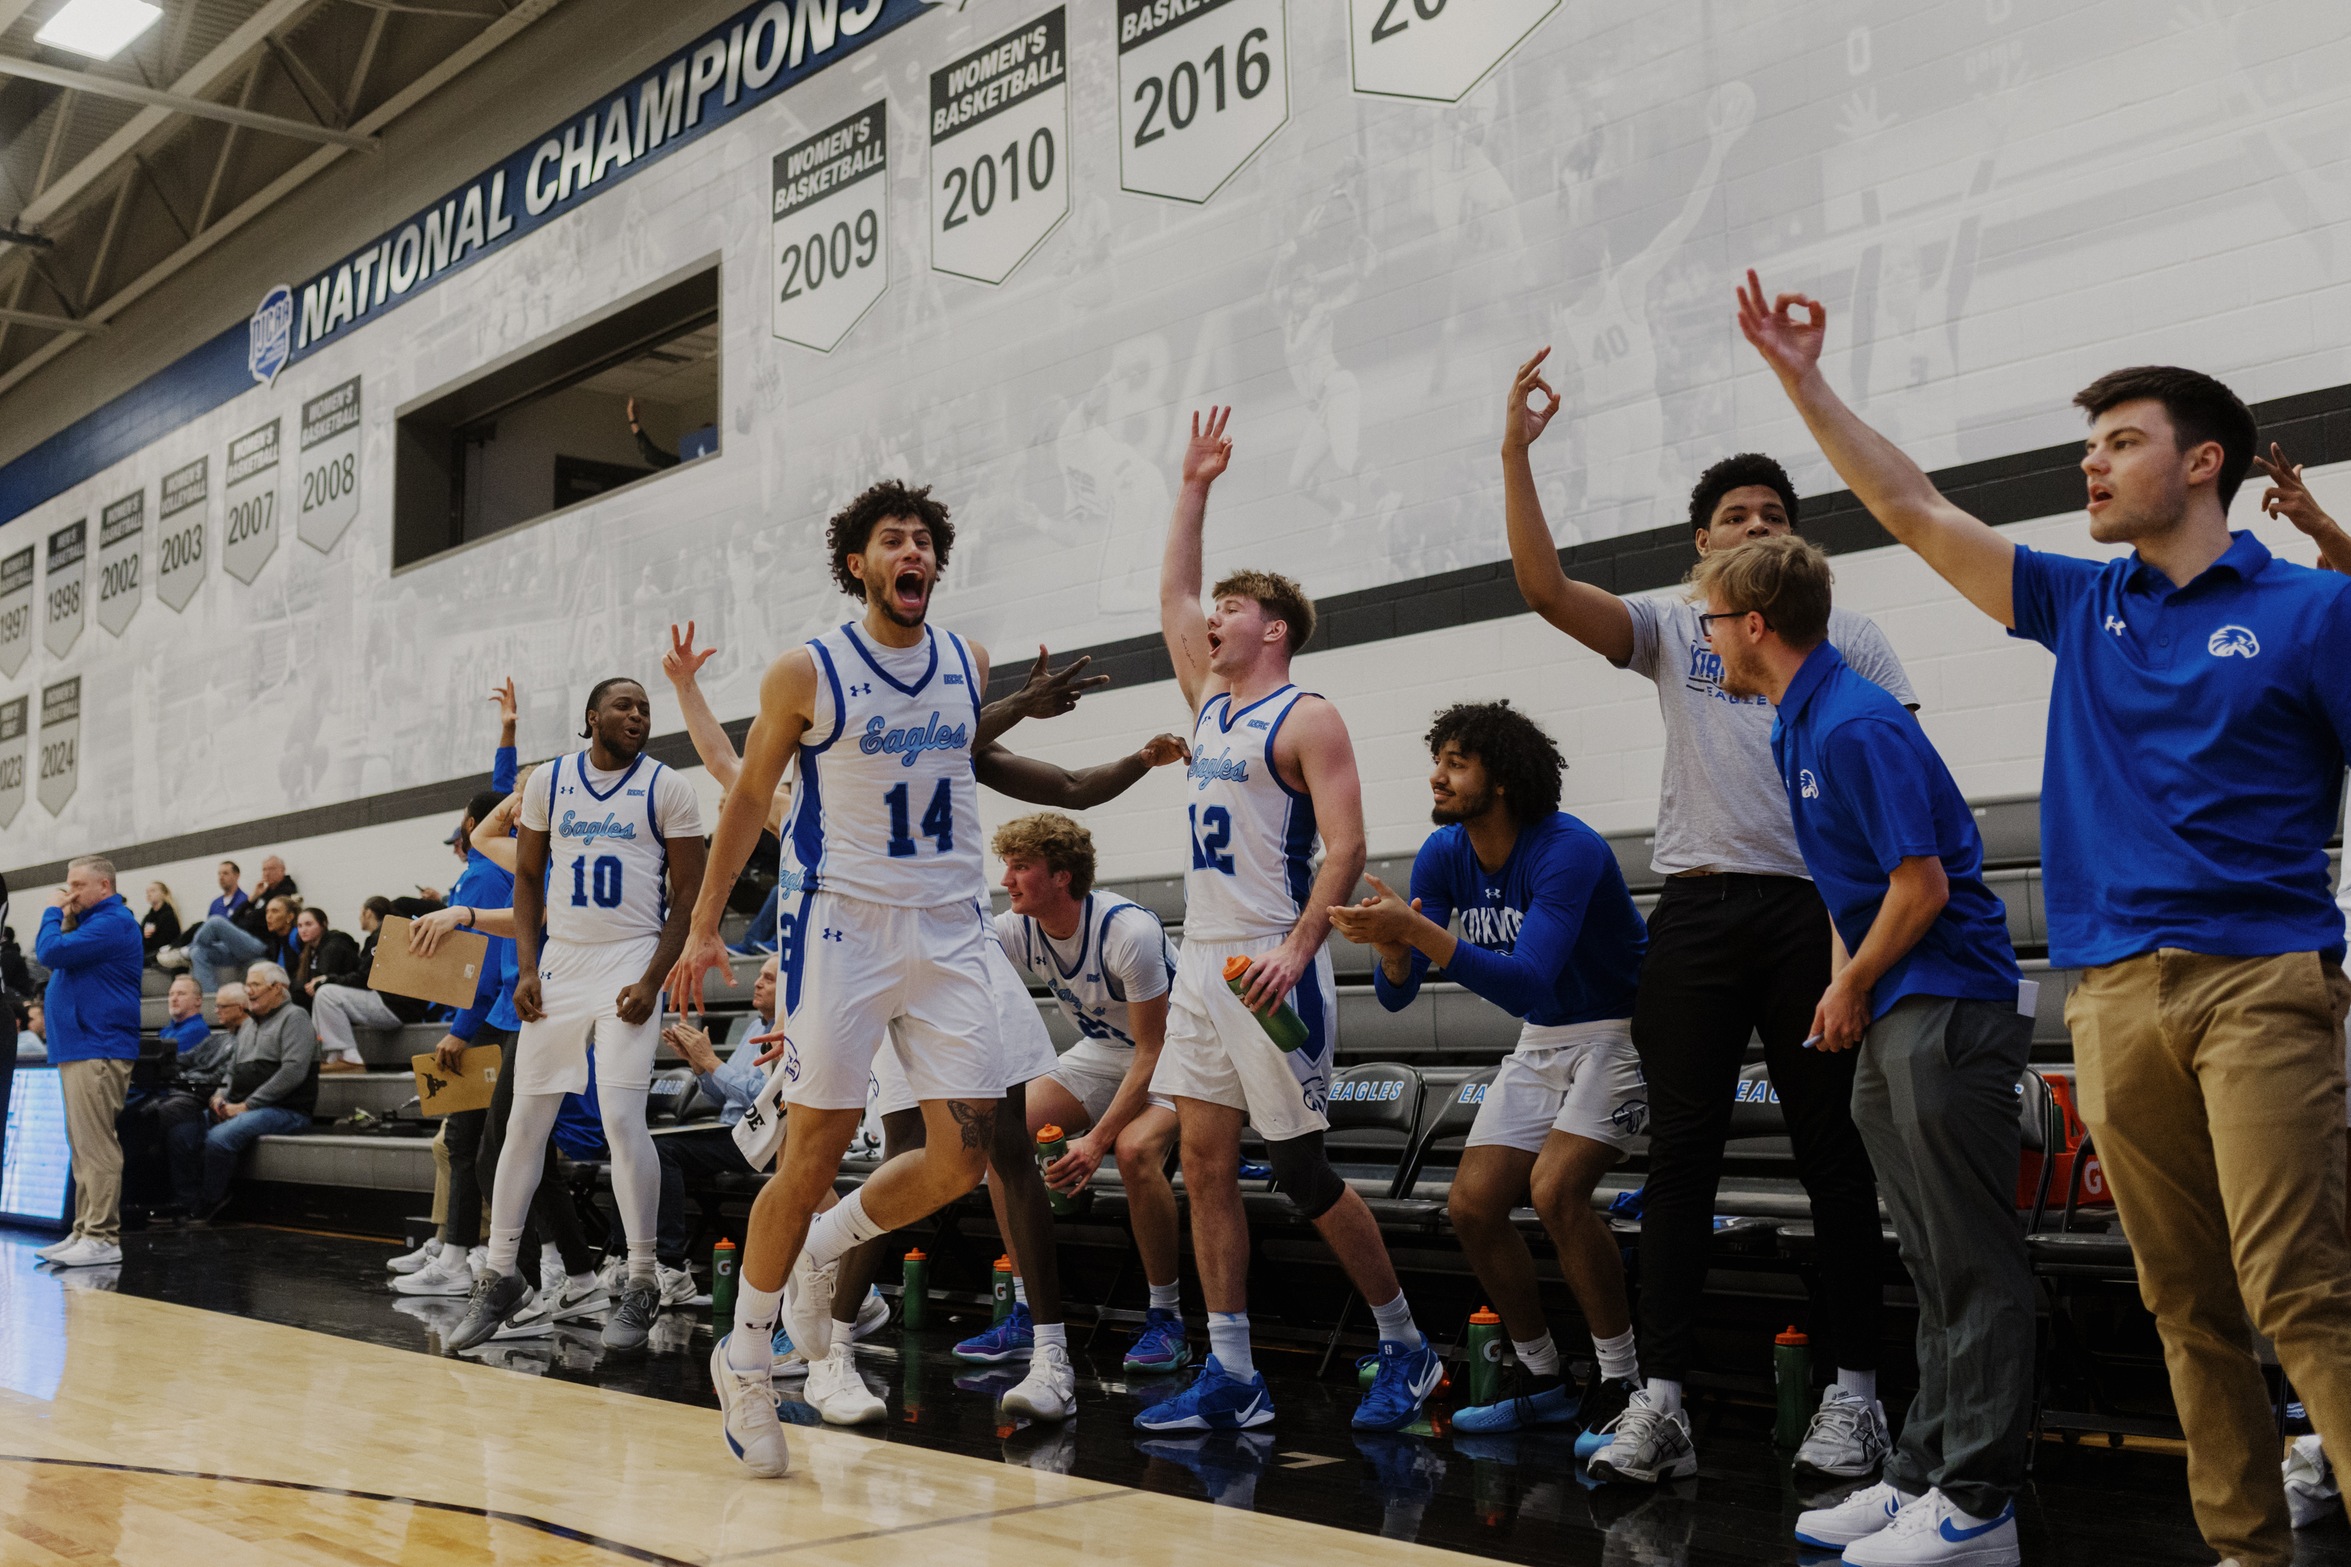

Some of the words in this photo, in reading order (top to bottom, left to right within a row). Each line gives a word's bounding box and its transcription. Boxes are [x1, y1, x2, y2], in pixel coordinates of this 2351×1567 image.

[948, 25, 1047, 97] WOMEN'S
[933, 50, 1063, 135] BASKETBALL
[1134, 27, 1270, 149] 2016
[788, 116, 871, 179] WOMEN'S
[774, 140, 884, 214] BASKETBALL
[943, 127, 1055, 232] 2010
[298, 171, 513, 349] NATIONAL
[781, 208, 878, 303] 2009
[301, 404, 359, 446] BASKETBALL
[309, 384, 354, 423] WOMEN'S
[227, 443, 279, 483] BASKETBALL
[233, 426, 275, 460] WOMEN'S
[303, 453, 354, 513] 2008
[228, 490, 274, 546] 2007
[161, 523, 202, 575] 2003
[48, 580, 80, 624] 1998
[101, 553, 139, 601] 2002
[0, 604, 28, 645] 1997
[41, 738, 74, 780] 2024
[860, 711, 968, 767] Eagles
[1187, 743, 1249, 790] Eagles
[559, 809, 637, 846] Eagles
[884, 778, 954, 857] 14
[1188, 803, 1236, 876] 12
[571, 855, 622, 908] 10
[1327, 1081, 1405, 1101] EAGLES
[2084, 1161, 2102, 1194] G
[717, 1259, 732, 1276] G
[994, 1282, 1007, 1300] G
